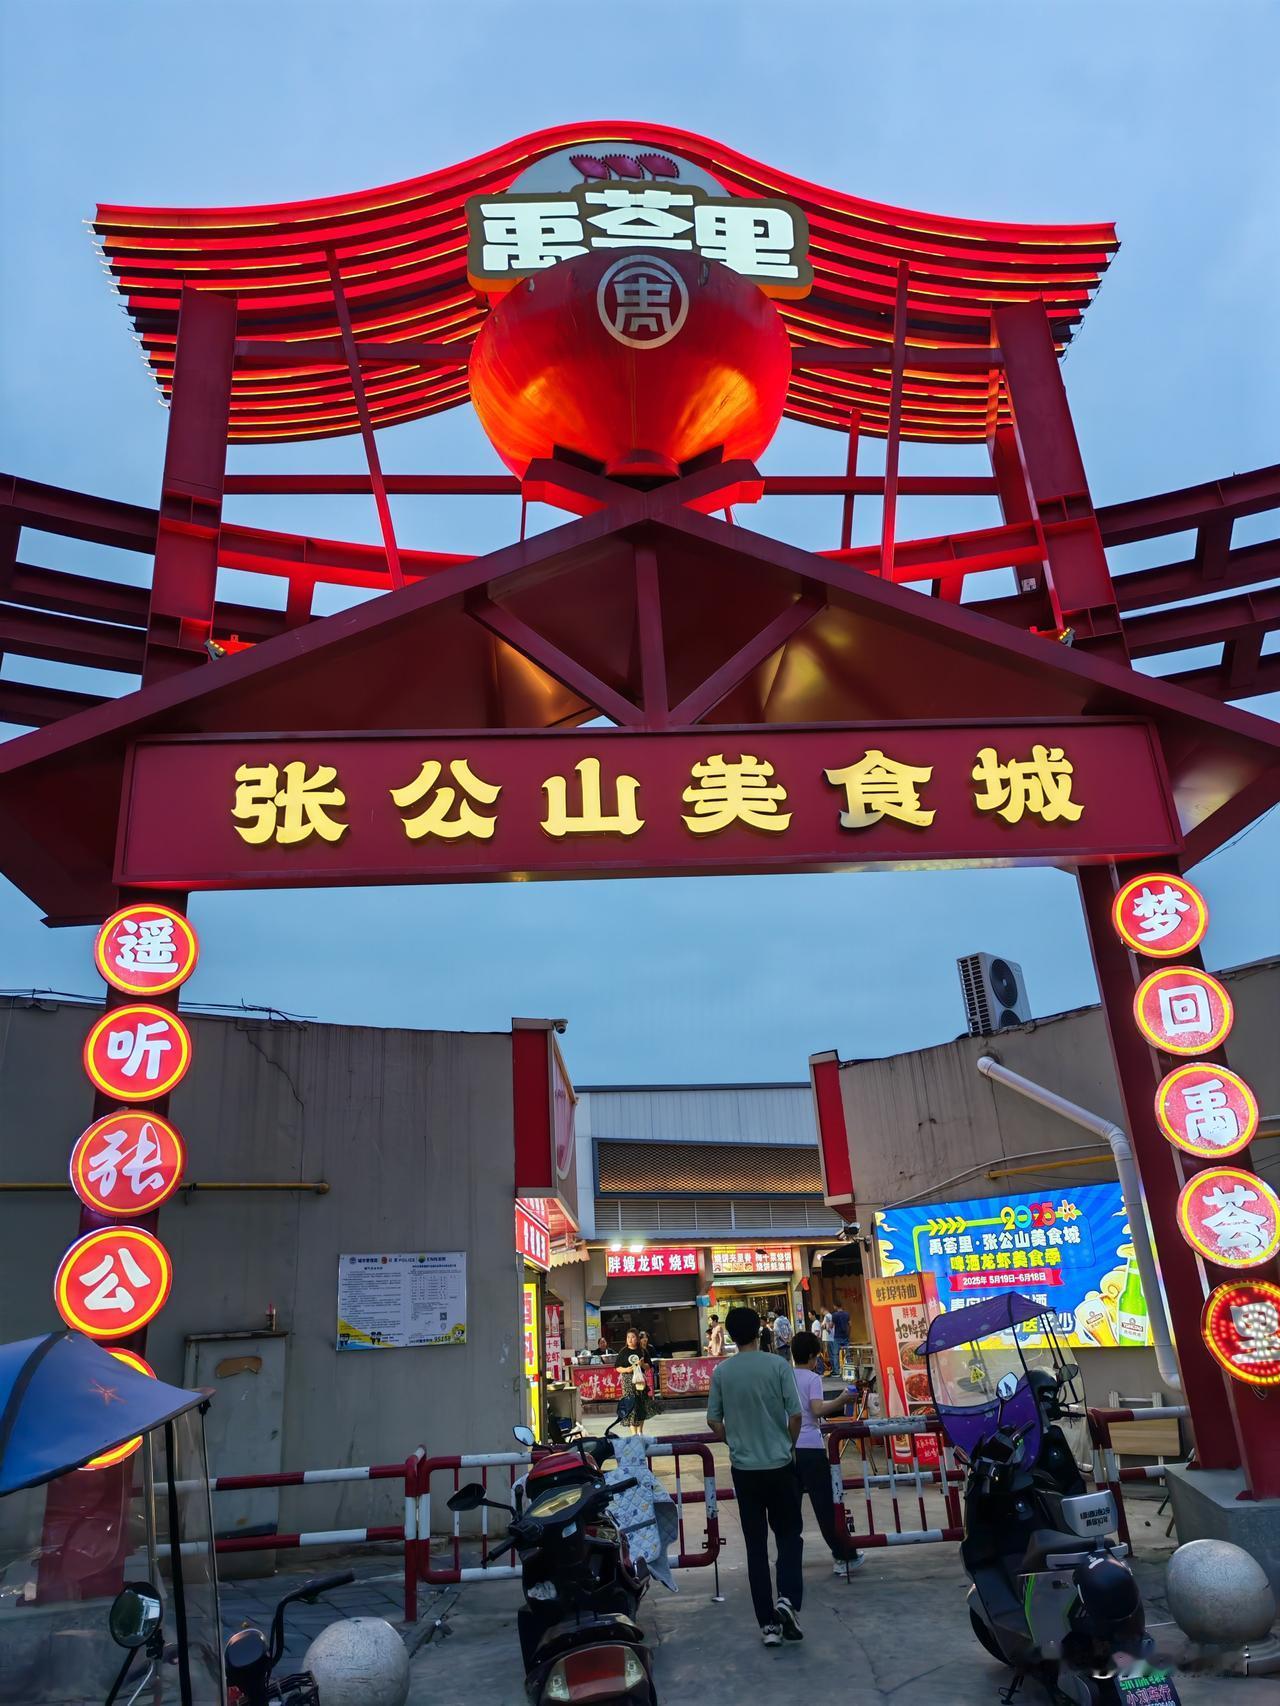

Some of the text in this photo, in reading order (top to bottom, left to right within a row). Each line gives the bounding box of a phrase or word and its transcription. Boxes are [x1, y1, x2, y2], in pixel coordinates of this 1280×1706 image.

[480, 189, 798, 279] 禹荟里
[233, 746, 1085, 845] 张公山美食城
[79, 918, 179, 1312] 遥听张公
[1132, 886, 1280, 1364] 梦回禹荟里
[1000, 1202, 1056, 1231] 2025
[929, 1225, 1081, 1256] 禹荟里·张公山美食城
[608, 1253, 696, 1273] 胖嫂龙虾 烧鸡
[950, 1247, 1062, 1272] 啤酒龙虾美食季
[875, 1283, 917, 1302] 蚌埠特曲
[963, 1273, 1046, 1286] 2025年 5月19日-6月18日
